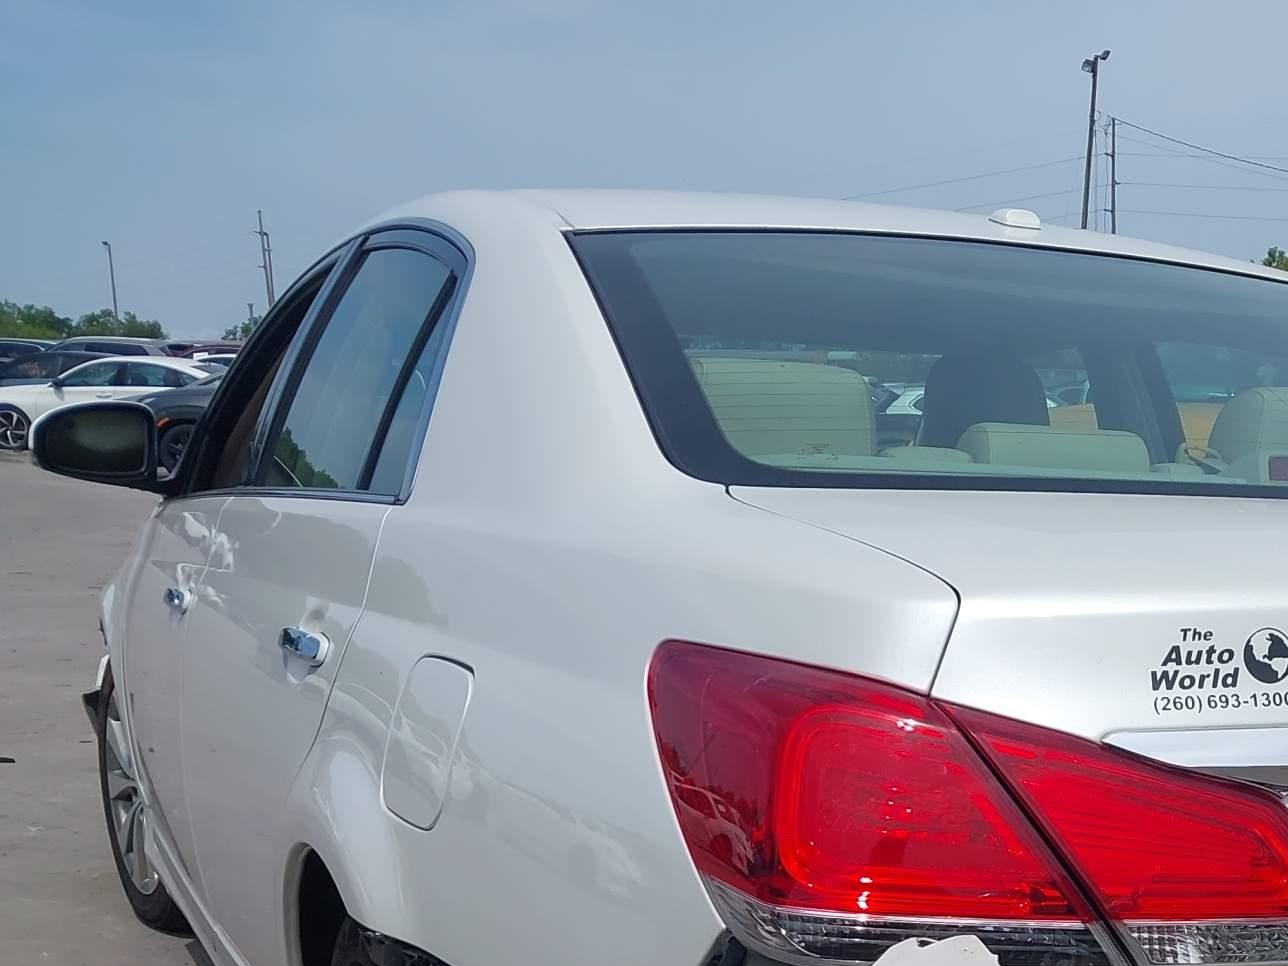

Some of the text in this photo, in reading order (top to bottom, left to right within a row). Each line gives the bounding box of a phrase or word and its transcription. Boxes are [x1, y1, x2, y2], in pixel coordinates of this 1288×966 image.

[1180, 628, 1214, 642] The
[1160, 644, 1235, 667] Auto
[1150, 667, 1240, 692] World
[1153, 695, 1203, 716] (260)
